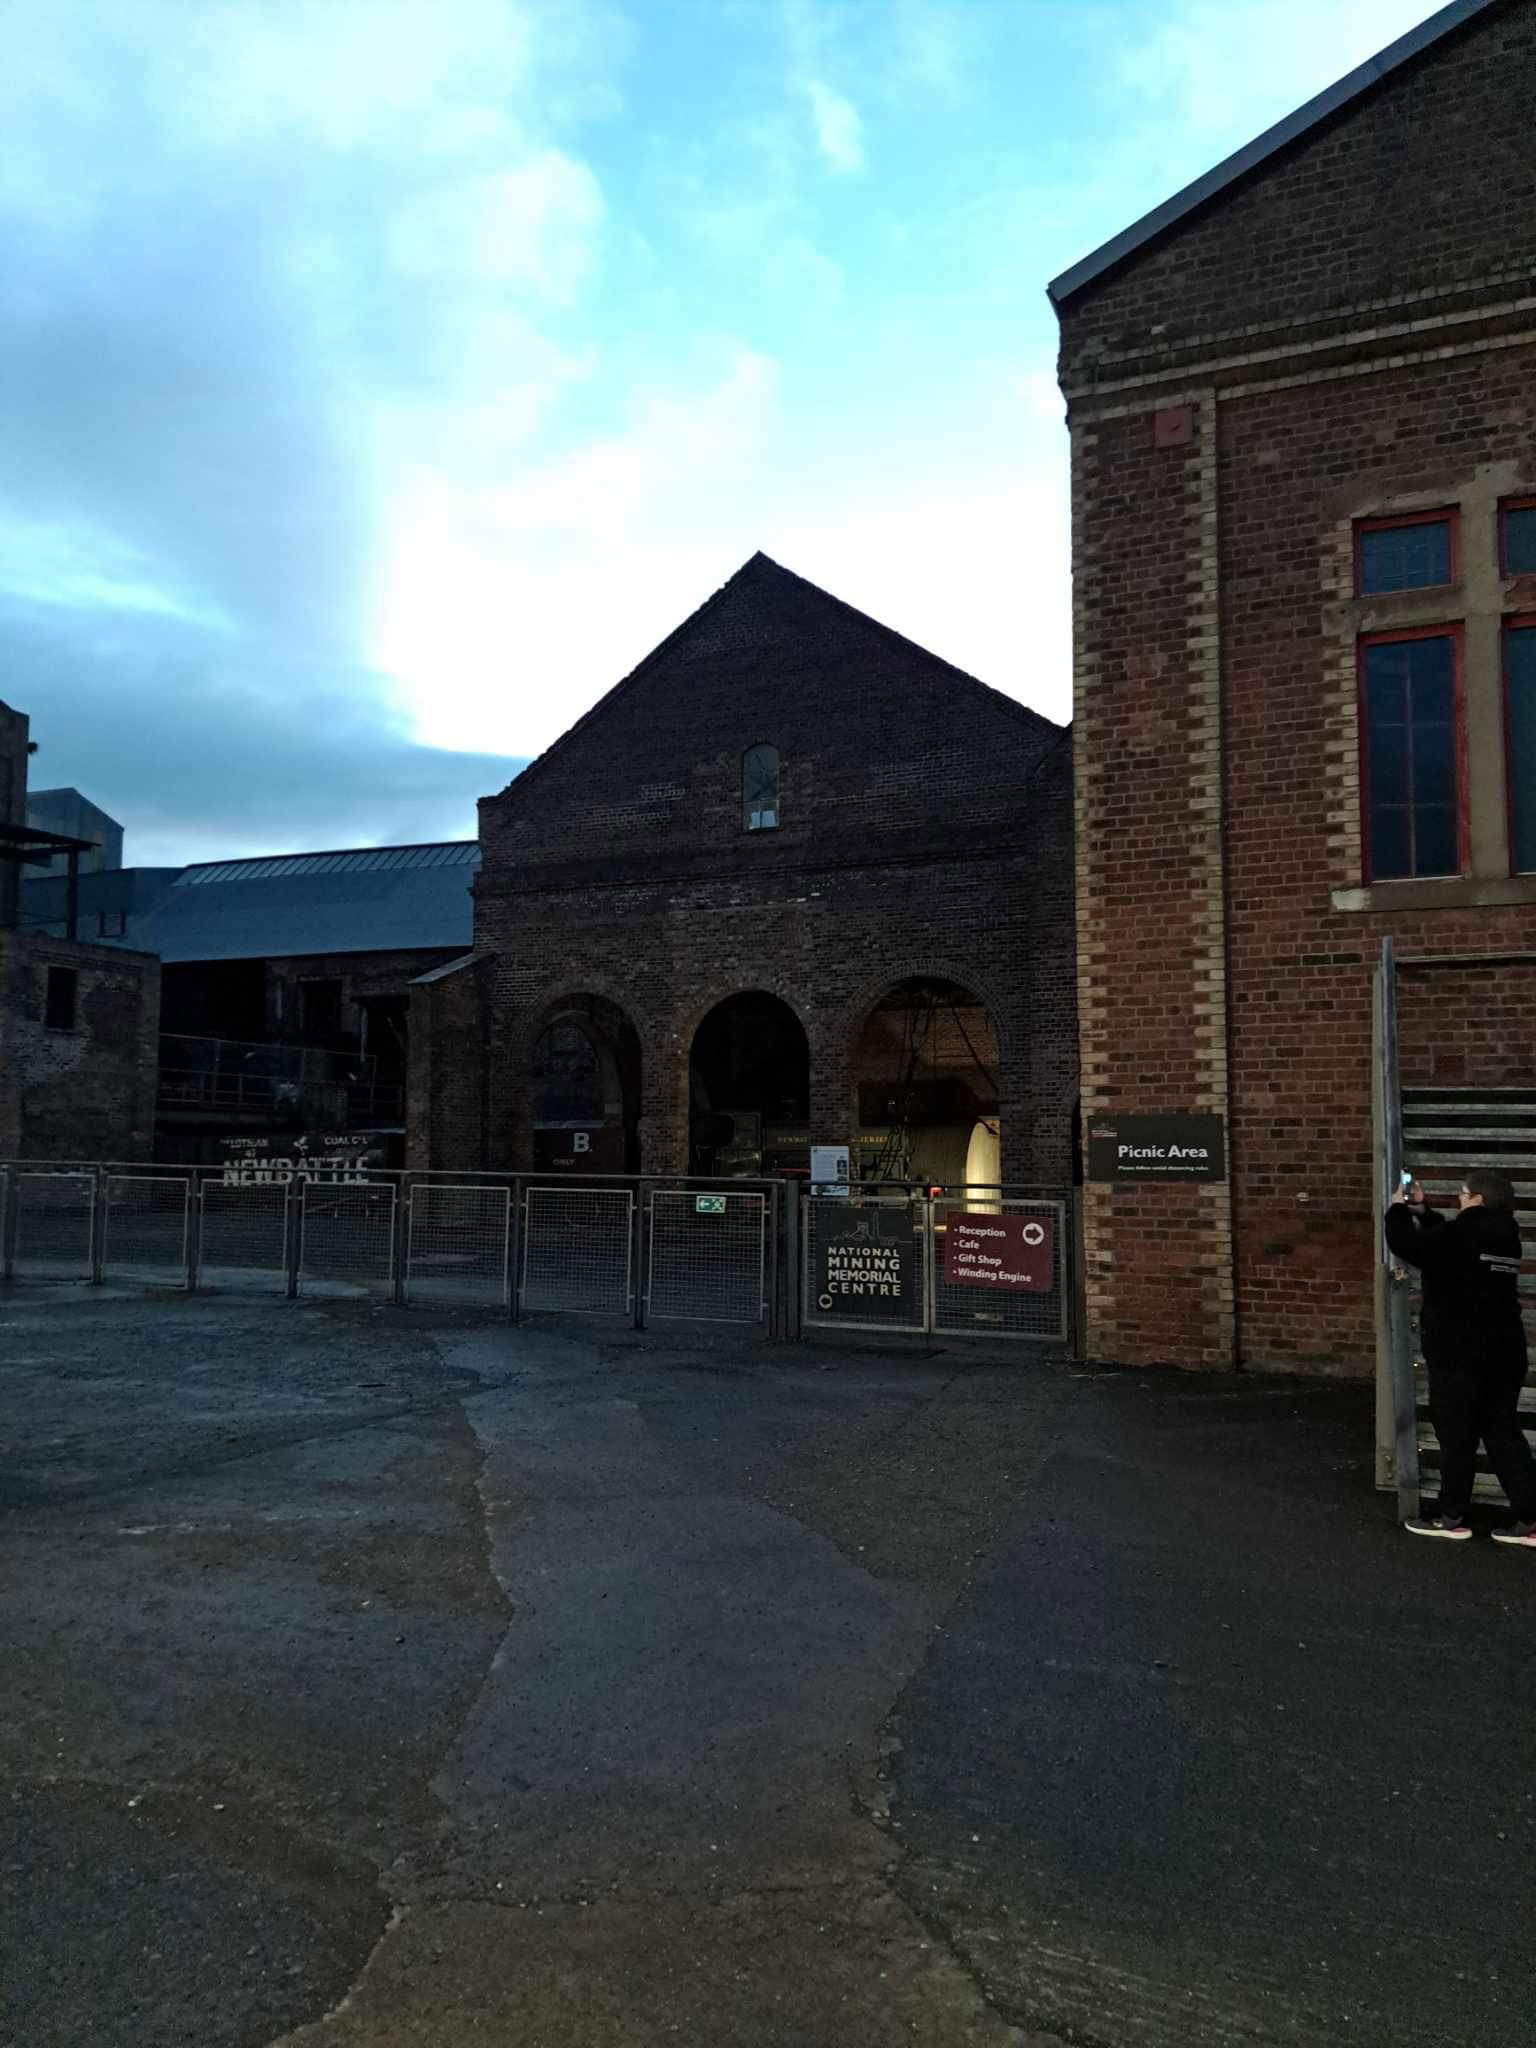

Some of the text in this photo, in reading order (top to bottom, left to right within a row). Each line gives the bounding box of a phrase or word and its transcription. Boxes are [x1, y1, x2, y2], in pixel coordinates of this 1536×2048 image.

[1118, 1144, 1209, 1159] Picnic Area
[223, 1157, 370, 1186] NEWBATTLE
[959, 1225, 1007, 1239] Reception
[827, 1246, 901, 1258] NATIONAL
[958, 1239, 981, 1250] Cafe
[827, 1256, 901, 1271] MINING
[958, 1253, 1003, 1267] Gift Shop
[827, 1269, 902, 1284] MEMORIAL
[957, 1267, 1033, 1283] Winding Engine
[827, 1282, 902, 1297] CENTRE
